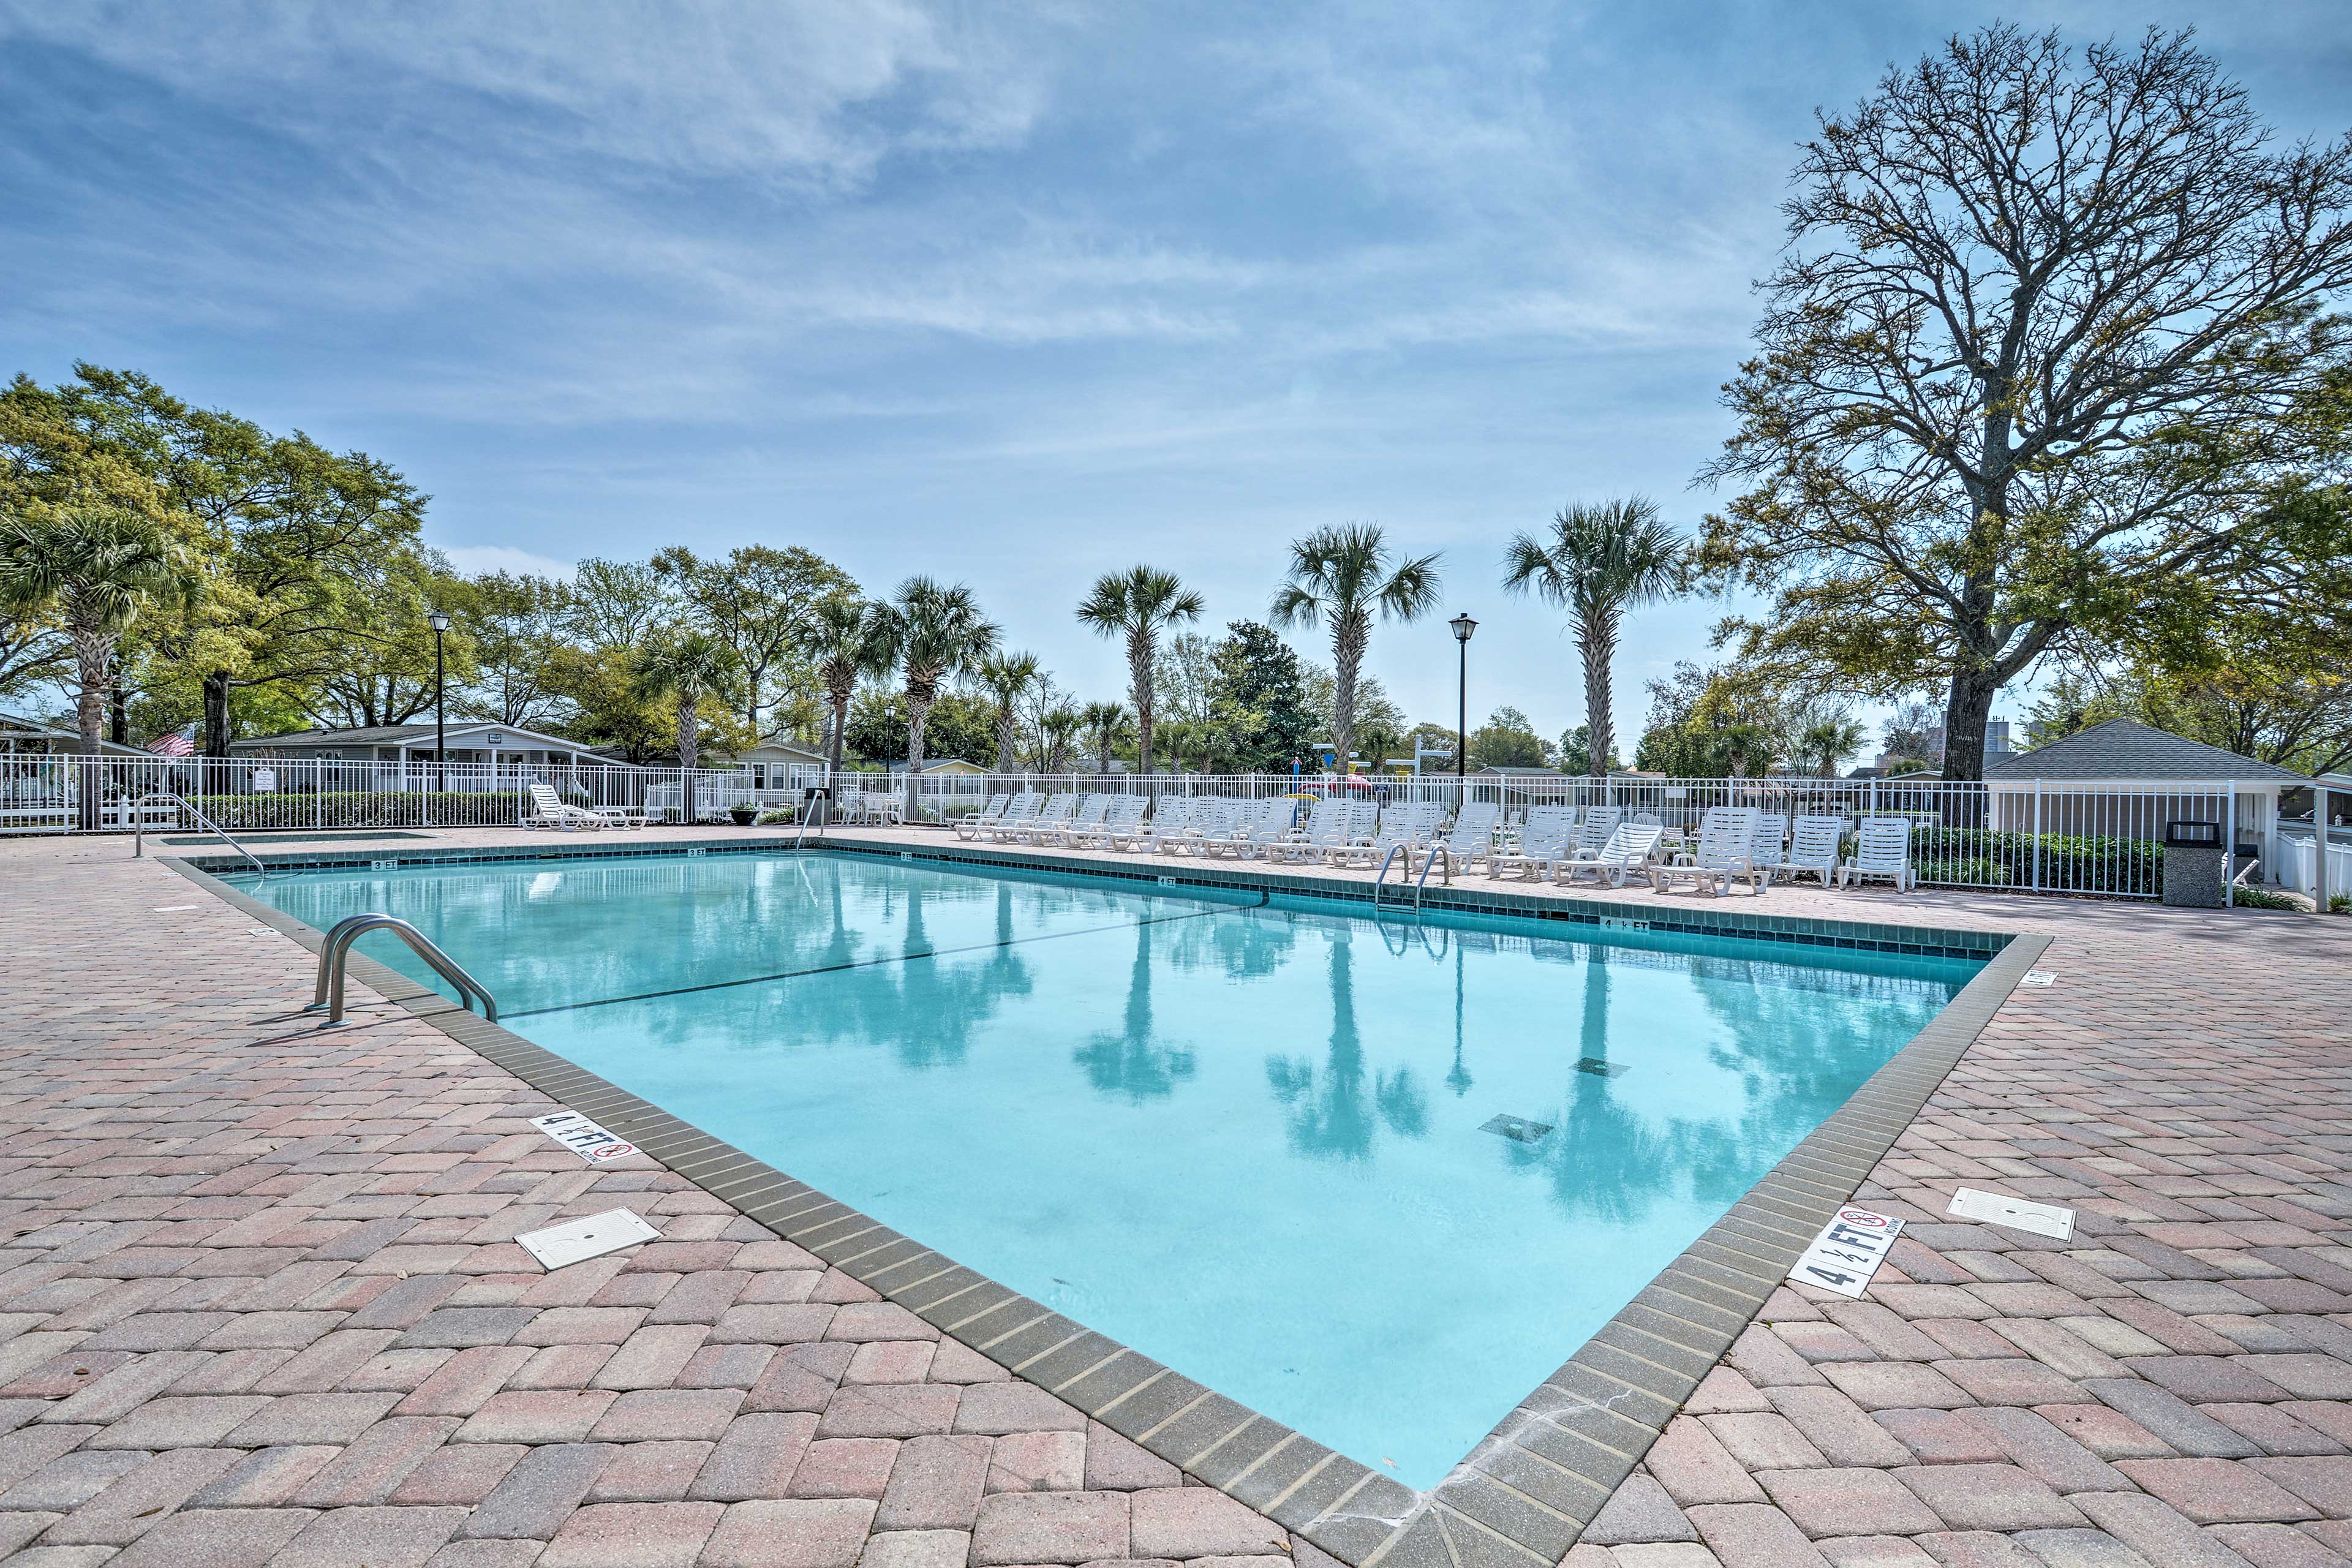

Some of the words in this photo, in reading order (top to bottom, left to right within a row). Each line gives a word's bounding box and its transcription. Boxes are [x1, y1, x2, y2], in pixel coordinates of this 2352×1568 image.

[542, 1116, 576, 1125] 4
[567, 1133, 616, 1147] FT
[584, 1153, 602, 1163] DIVING
[1887, 1218, 1902, 1230] DIVING
[1827, 1224, 1883, 1251] FT
[1806, 1265, 1856, 1286] 4
